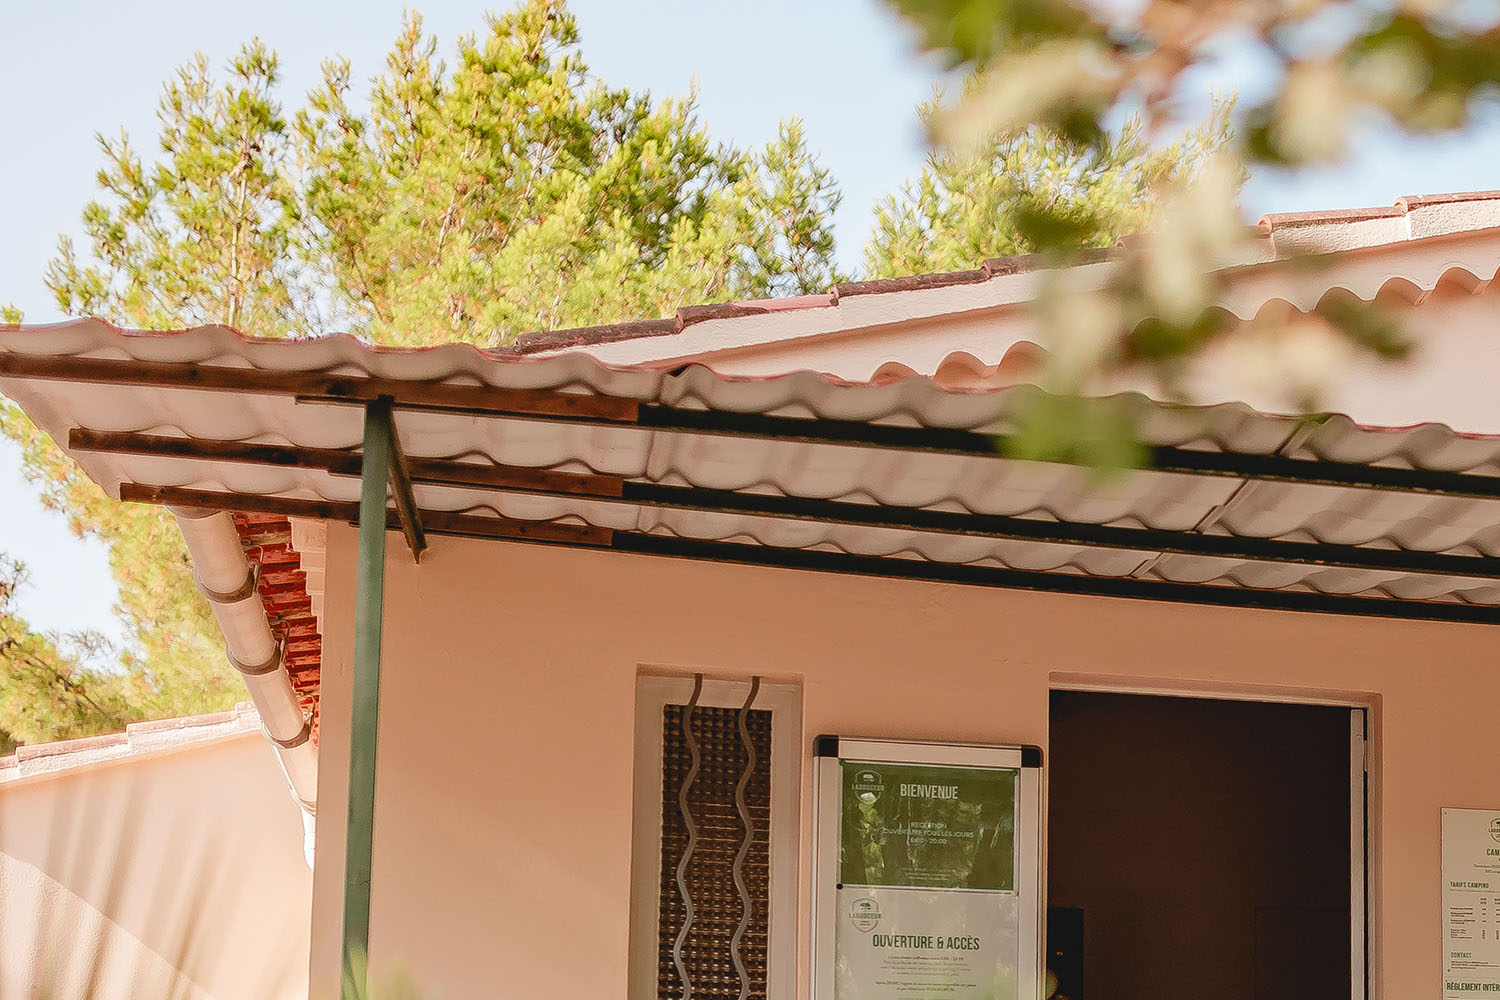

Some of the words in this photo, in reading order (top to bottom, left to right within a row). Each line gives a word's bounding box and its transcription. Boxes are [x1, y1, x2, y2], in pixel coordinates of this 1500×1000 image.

[900, 783, 958, 800] BIENVENUE
[872, 934, 934, 949] OUVERTURE
[937, 936, 944, 950] &
[946, 935, 980, 950] ACCÈS
